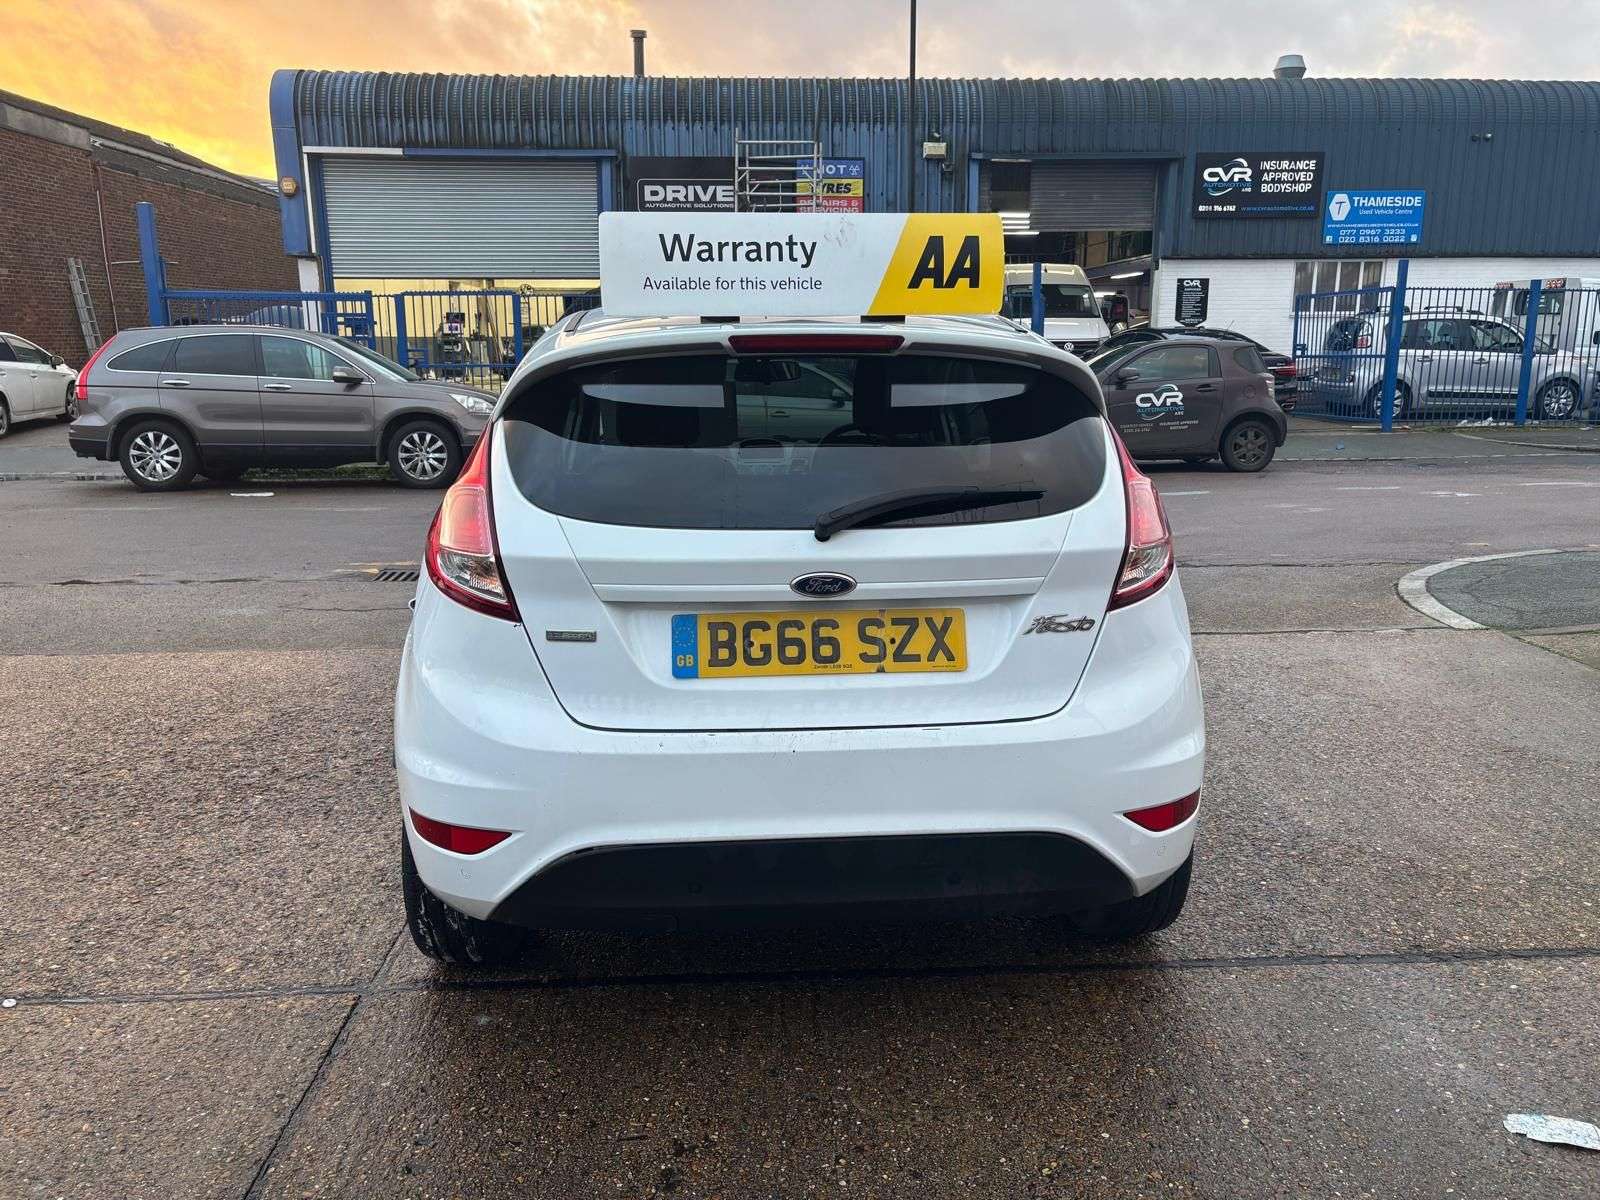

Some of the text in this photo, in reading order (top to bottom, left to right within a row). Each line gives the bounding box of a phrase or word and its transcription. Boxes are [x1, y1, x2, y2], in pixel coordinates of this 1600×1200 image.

[1260, 159, 1317, 170] INSURANCE
[1203, 167, 1253, 182] CVR
[1261, 171, 1314, 181] APPROVED
[643, 184, 735, 202] DRIVE
[1260, 183, 1312, 193] BODYSHOP
[1352, 196, 1422, 207] THAMESIDE
[658, 232, 818, 269] Warranty
[907, 235, 981, 290] AA
[643, 276, 823, 291] Available for this vehicle
[1183, 279, 1202, 288] CVR
[1135, 391, 1184, 407] CVR
[1136, 405, 1185, 413] AUTOMOTIVE
[805, 577, 842, 592] Ford
[706, 616, 957, 668] BG66 SZX
[676, 654, 694, 667] GB
